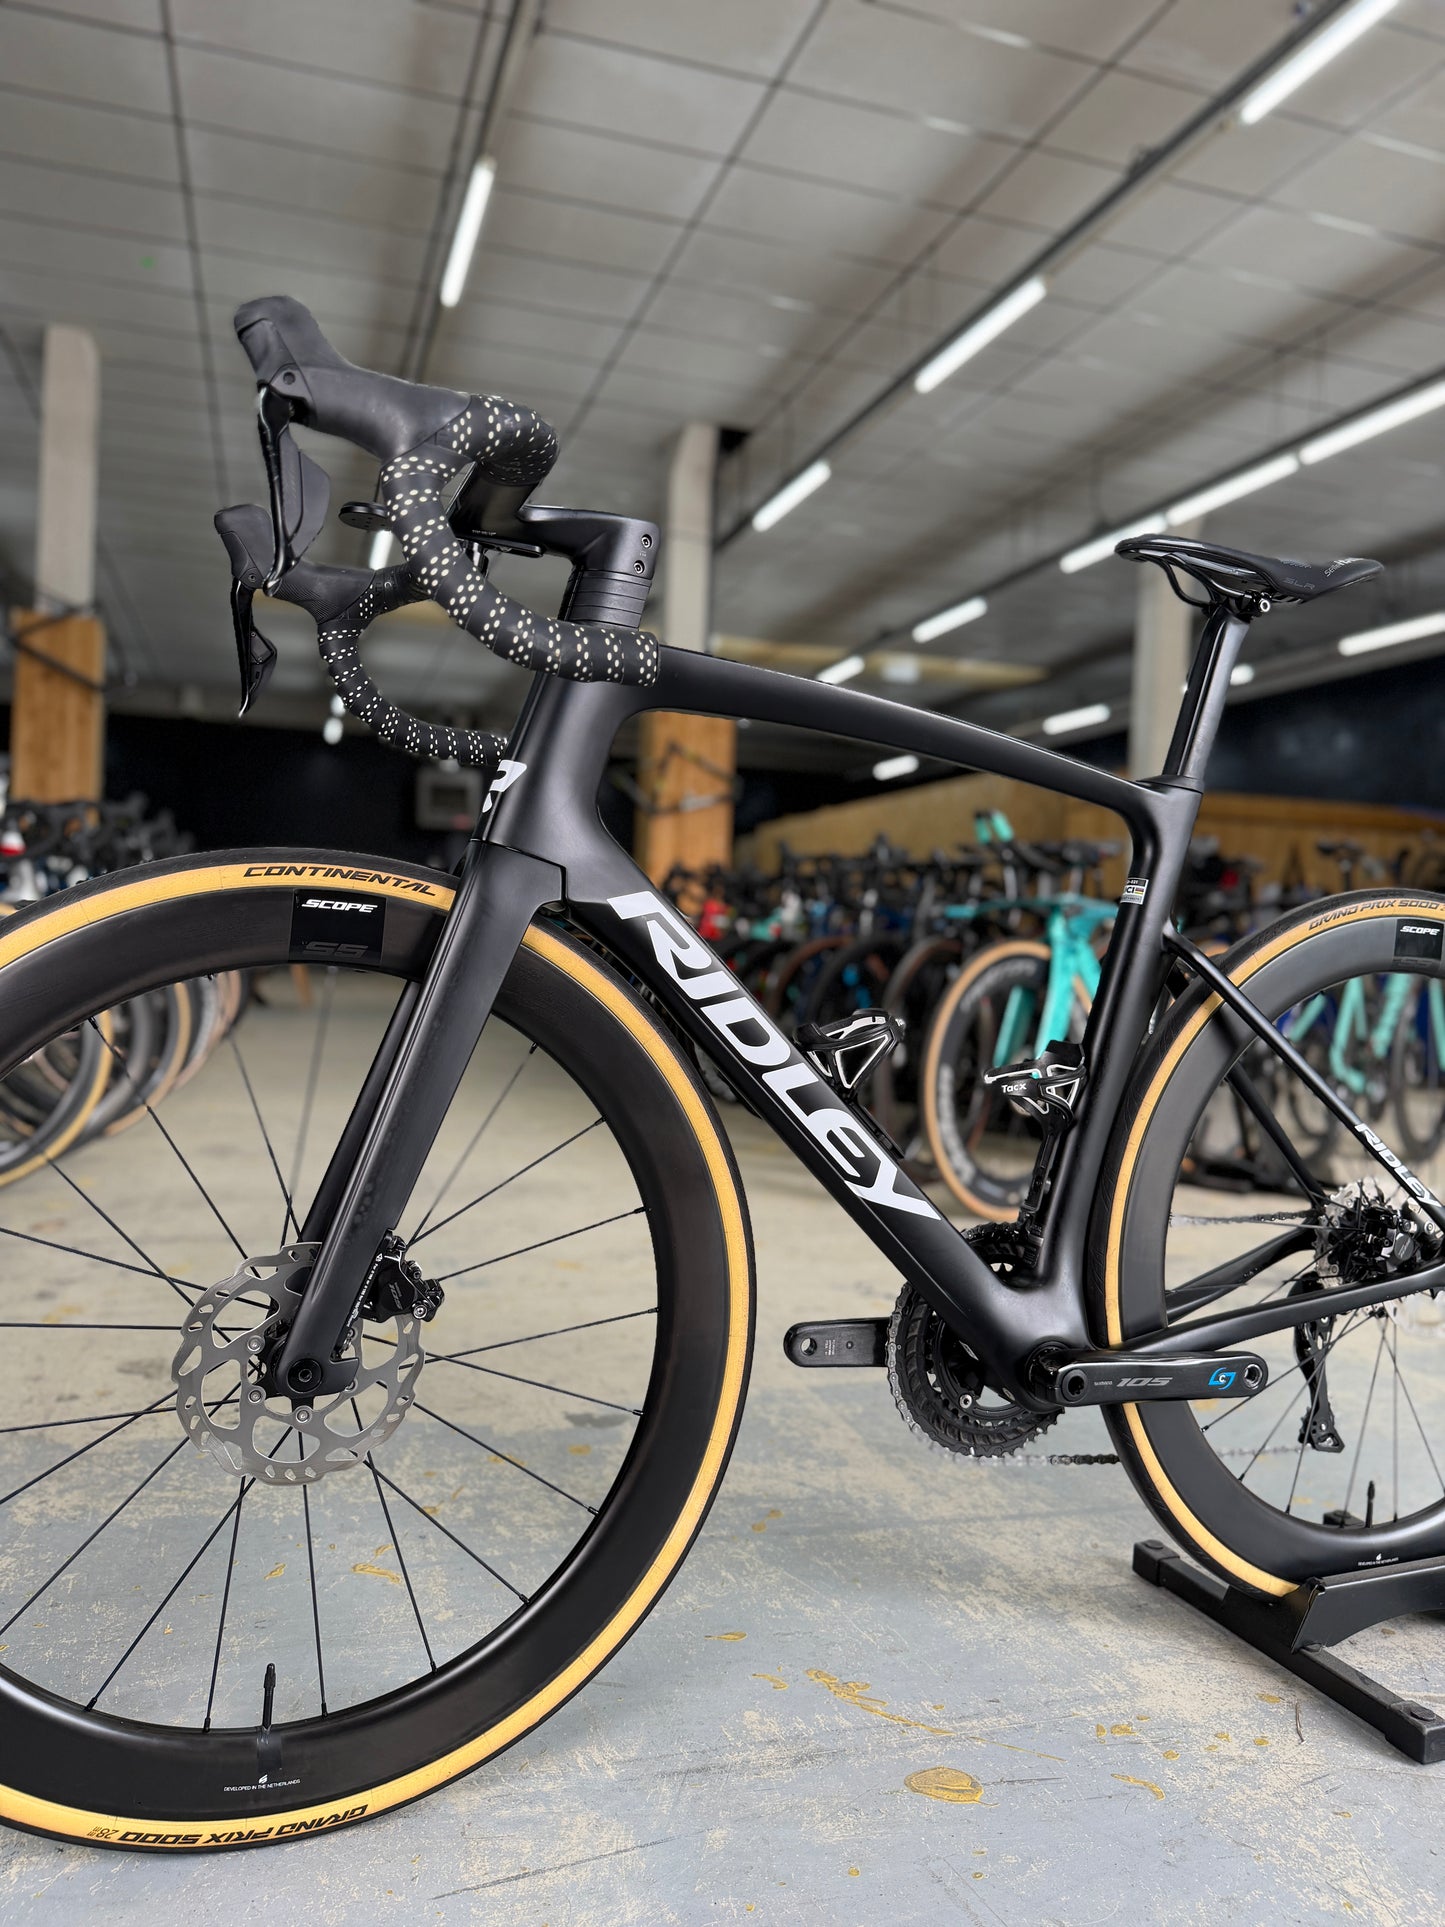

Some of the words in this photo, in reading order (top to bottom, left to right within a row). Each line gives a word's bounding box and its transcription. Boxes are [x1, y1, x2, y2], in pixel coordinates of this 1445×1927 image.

[243, 865, 436, 896] CONTINENTAL
[301, 898, 378, 913] SCOPE
[1308, 905, 1359, 930] GRAND
[1360, 899, 1396, 912] PRIX
[1398, 900, 1440, 910] 5000
[1400, 925, 1440, 936] SCOPE
[1116, 1377, 1173, 1387] 105
[275, 1804, 369, 1836] GRAND
[117, 1831, 202, 1844] 5000
[202, 1827, 274, 1844] PRIX
